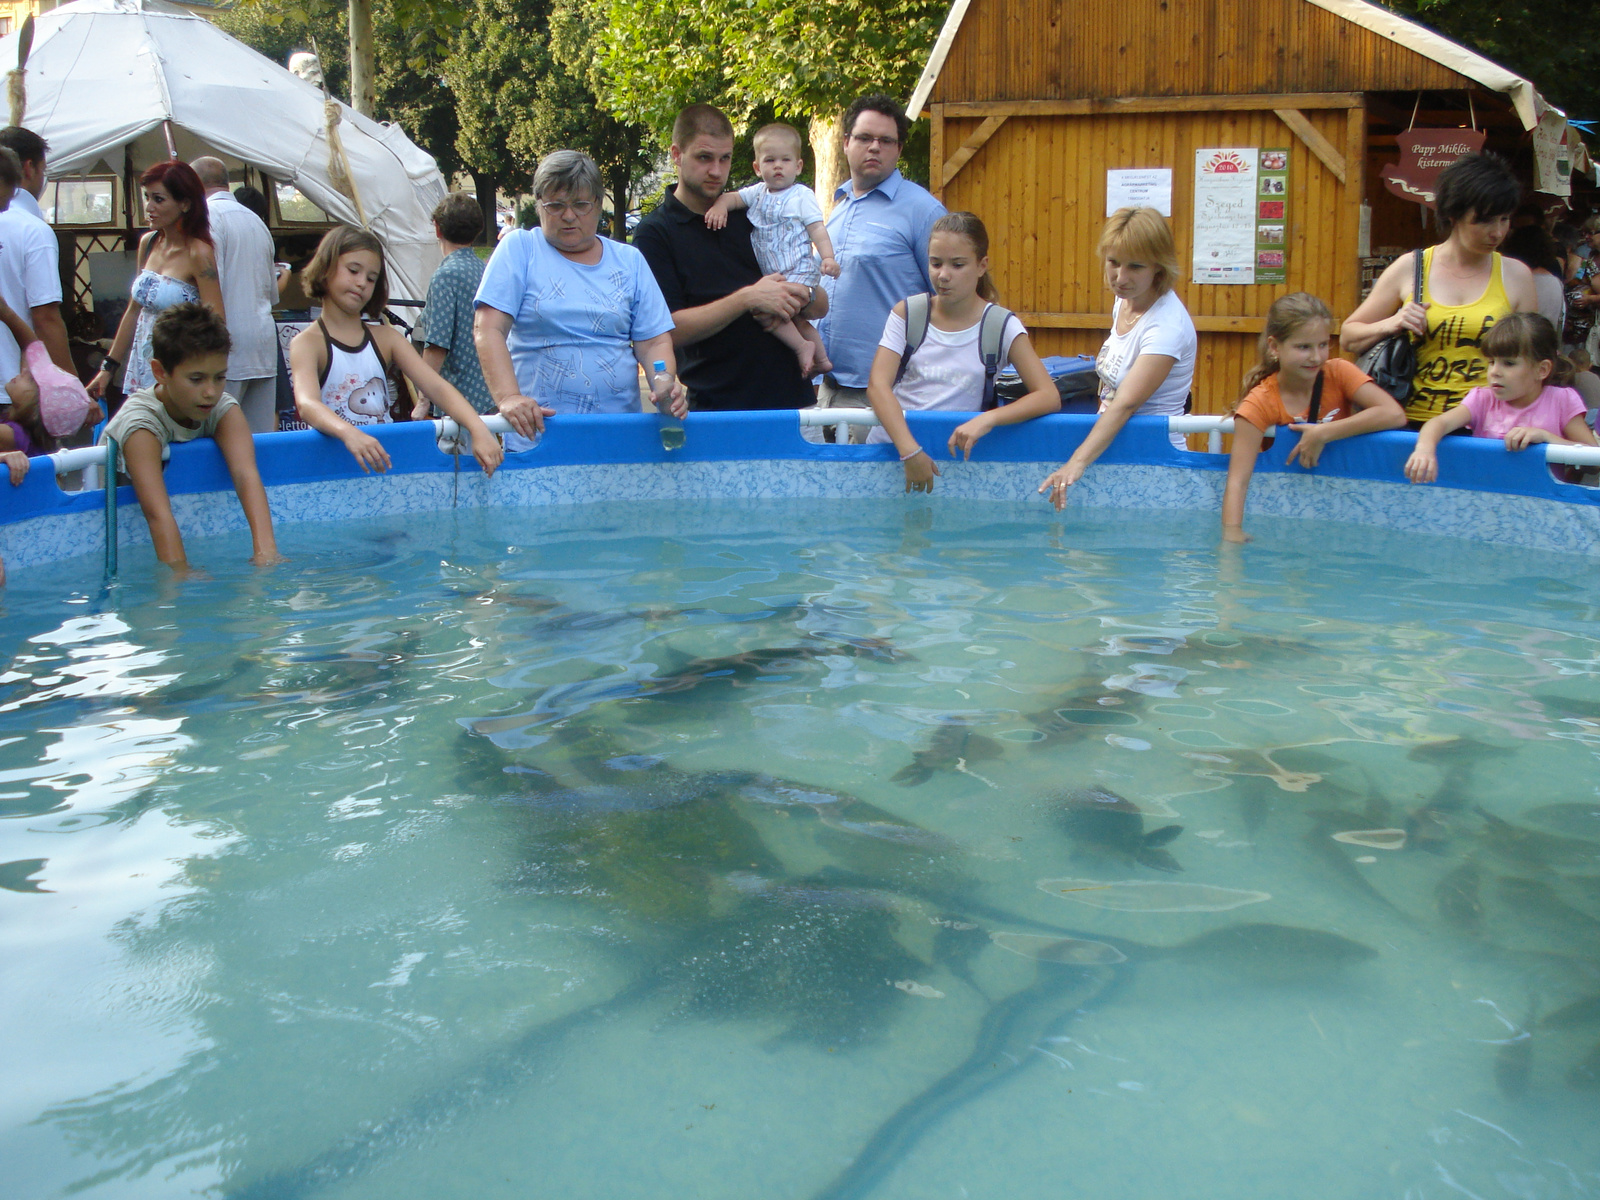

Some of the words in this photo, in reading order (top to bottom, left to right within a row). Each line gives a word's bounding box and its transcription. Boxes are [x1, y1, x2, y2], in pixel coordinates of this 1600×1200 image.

[1411, 143, 1436, 157] Papp
[1437, 143, 1471, 156] Miklós
[1417, 156, 1457, 169] kisterme
[1205, 194, 1244, 214] Szeged
[1425, 315, 1494, 351] MILE
